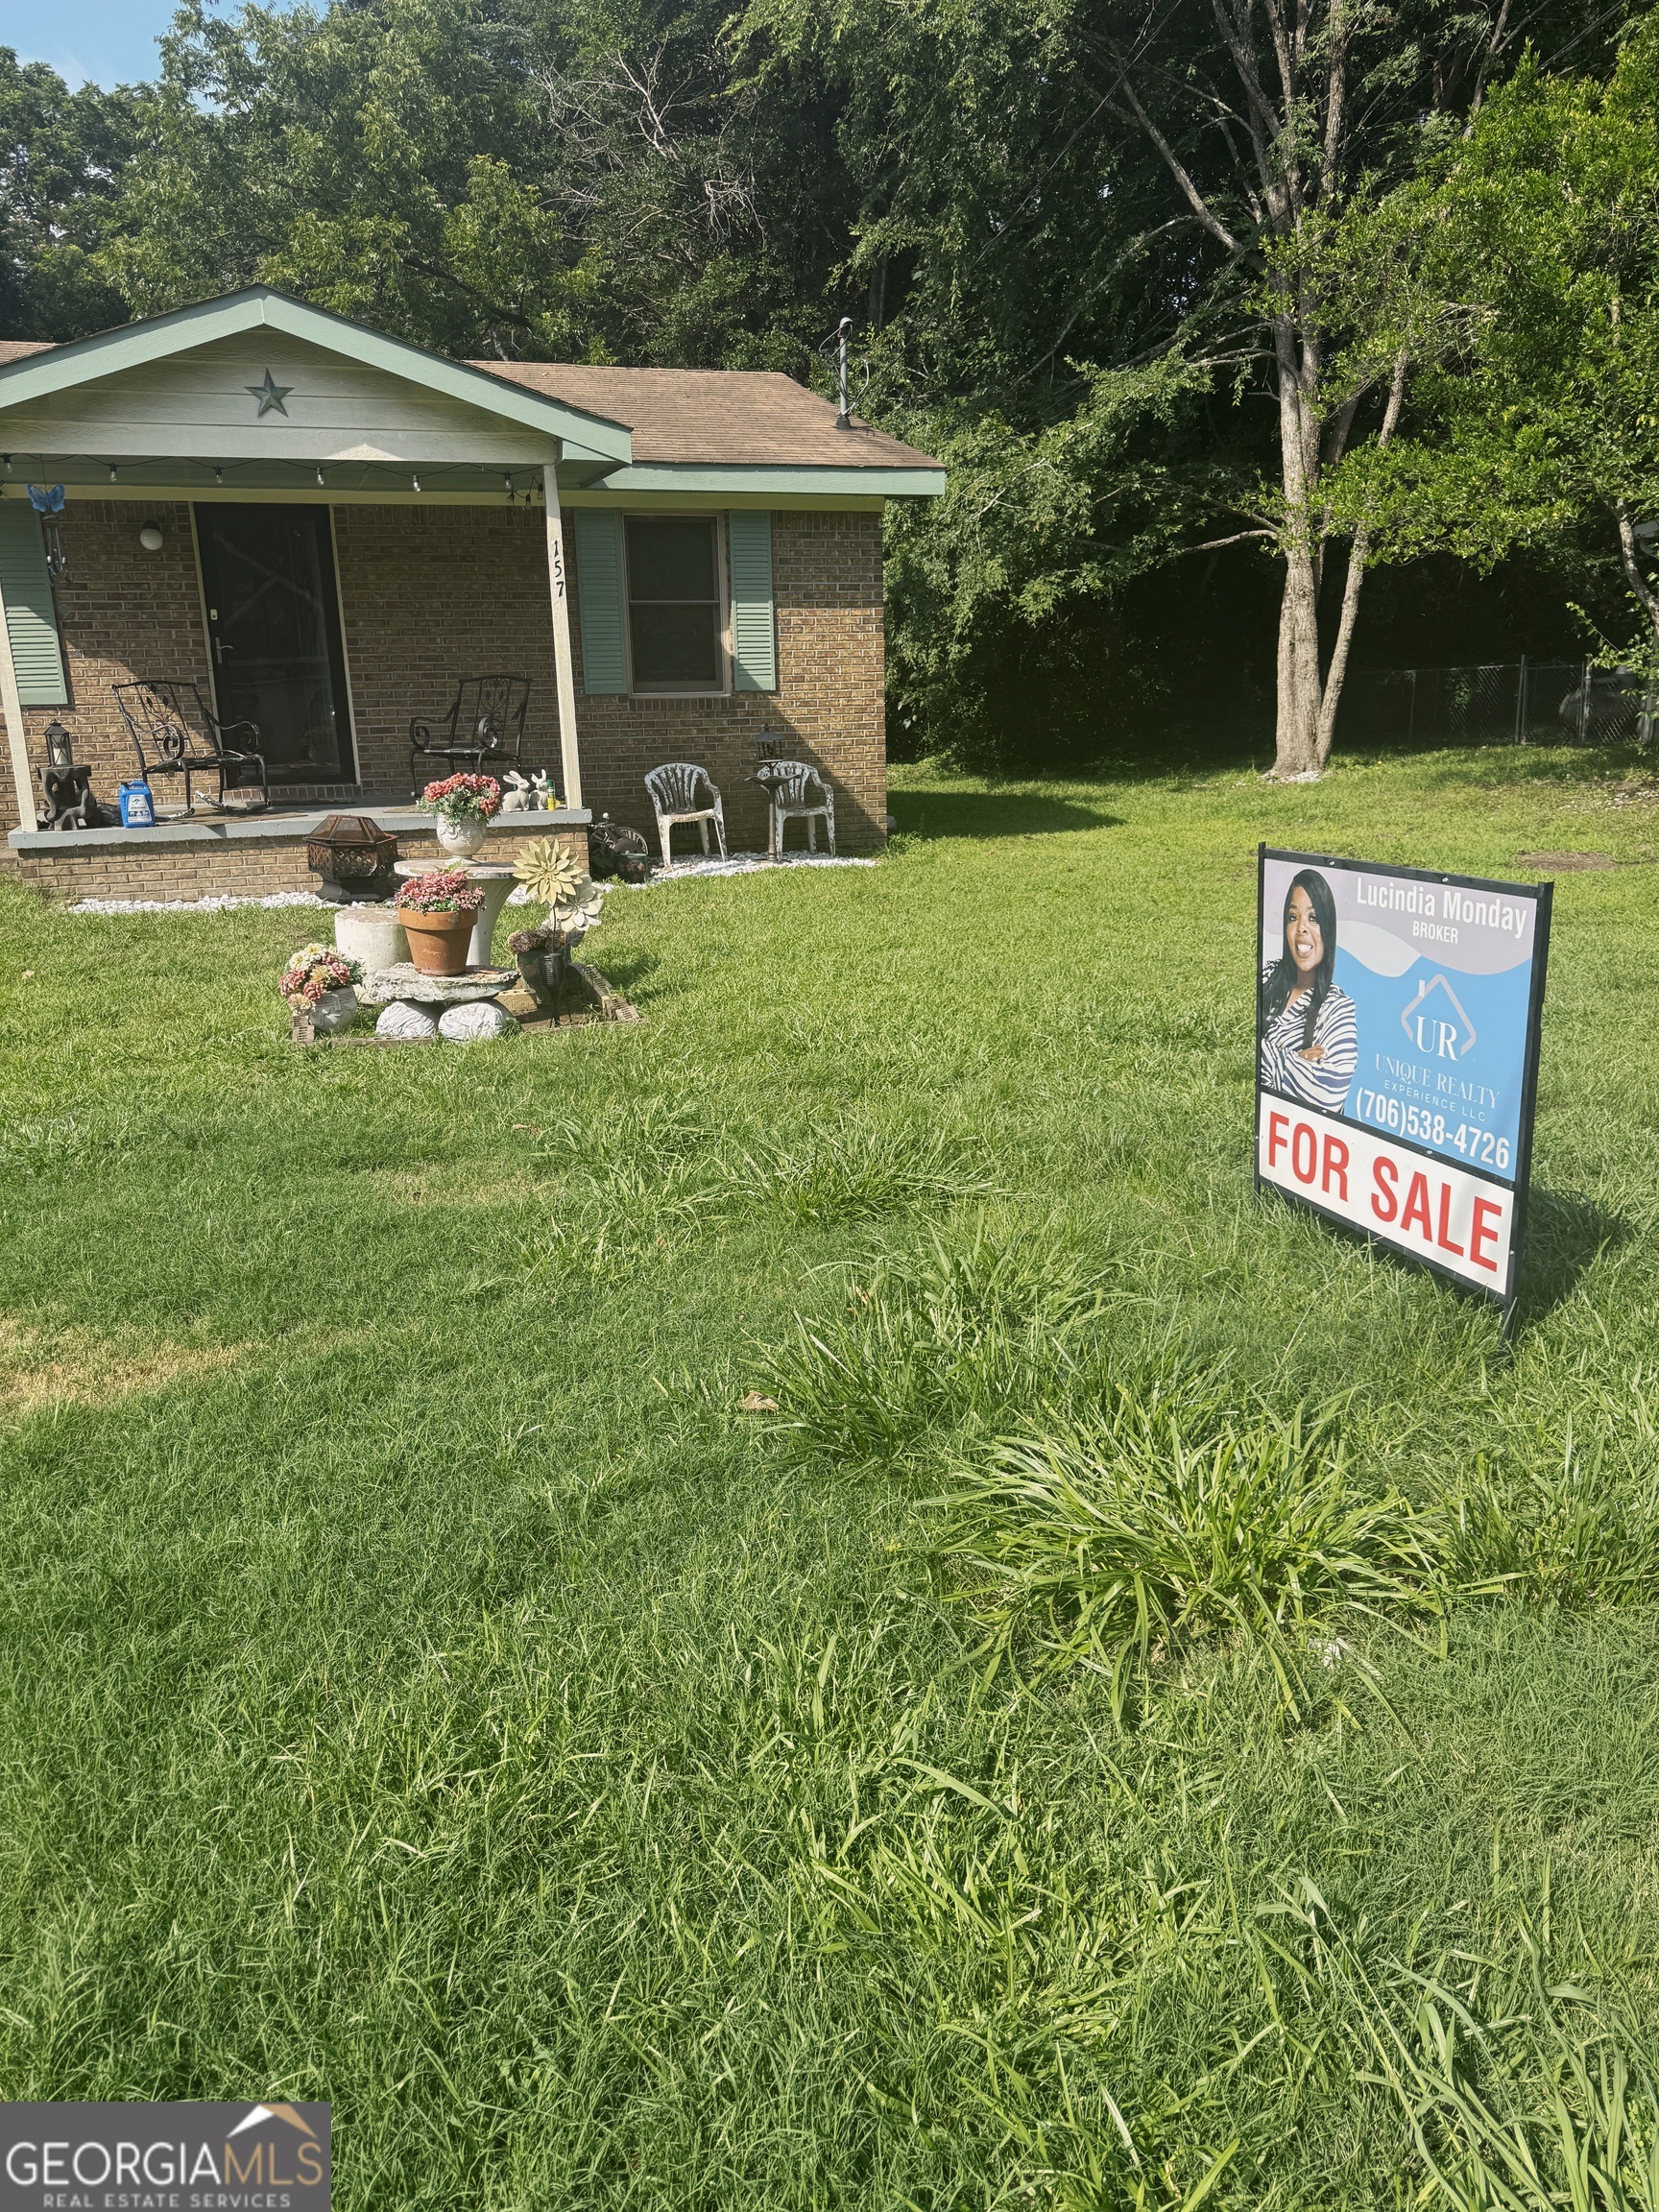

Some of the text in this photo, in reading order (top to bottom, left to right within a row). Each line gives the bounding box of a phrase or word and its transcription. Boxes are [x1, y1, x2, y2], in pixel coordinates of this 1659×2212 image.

[554, 540, 565, 597] 157
[1357, 877, 1527, 939] Lucindia Monday
[1412, 920, 1458, 944] BROKER
[1416, 1015, 1458, 1062] UR
[1375, 1053, 1500, 1109] UNIQUE REALTY
[1384, 1082, 1485, 1122] EXPERIENCE LLC
[1356, 1087, 1510, 1169] (706)538-4726
[1268, 1111, 1503, 1273] FOR SALE
